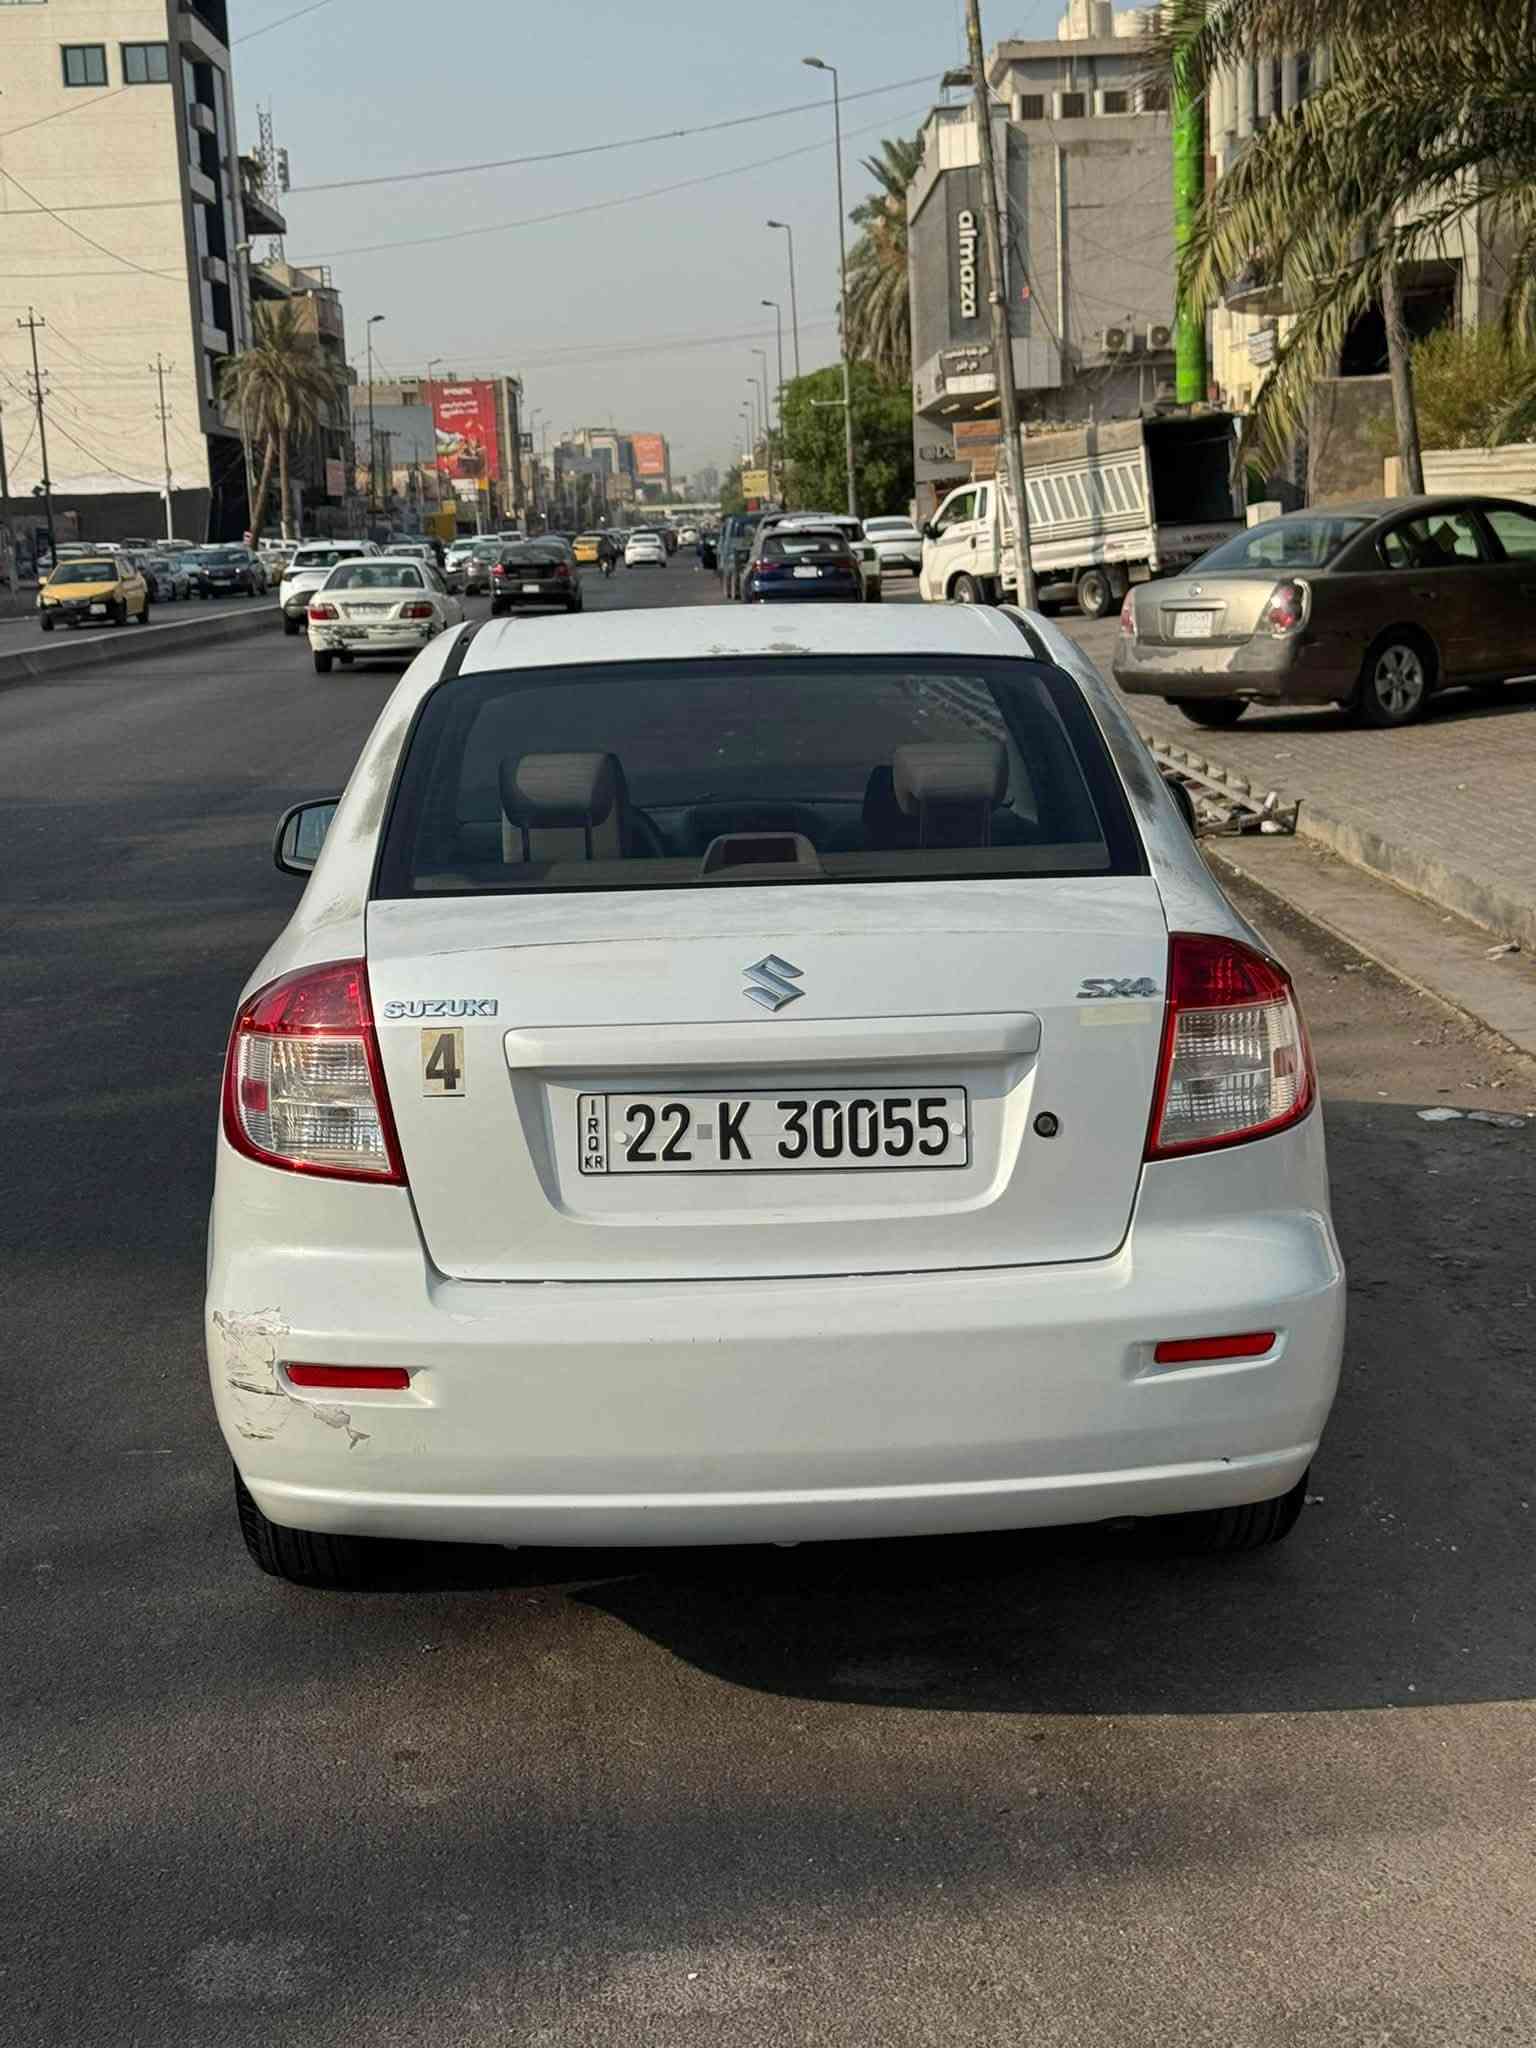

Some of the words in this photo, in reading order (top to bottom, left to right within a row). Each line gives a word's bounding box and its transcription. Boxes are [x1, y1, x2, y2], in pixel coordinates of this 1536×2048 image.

[959, 210, 978, 319] almaza
[1076, 977, 1157, 999] SX4
[384, 999, 498, 1019] SUZUKI
[425, 1033, 461, 1090] 4
[626, 1103, 692, 1162] 22
[719, 1101, 752, 1161] K
[777, 1097, 949, 1159] 30055
[584, 1155, 604, 1169] KR
